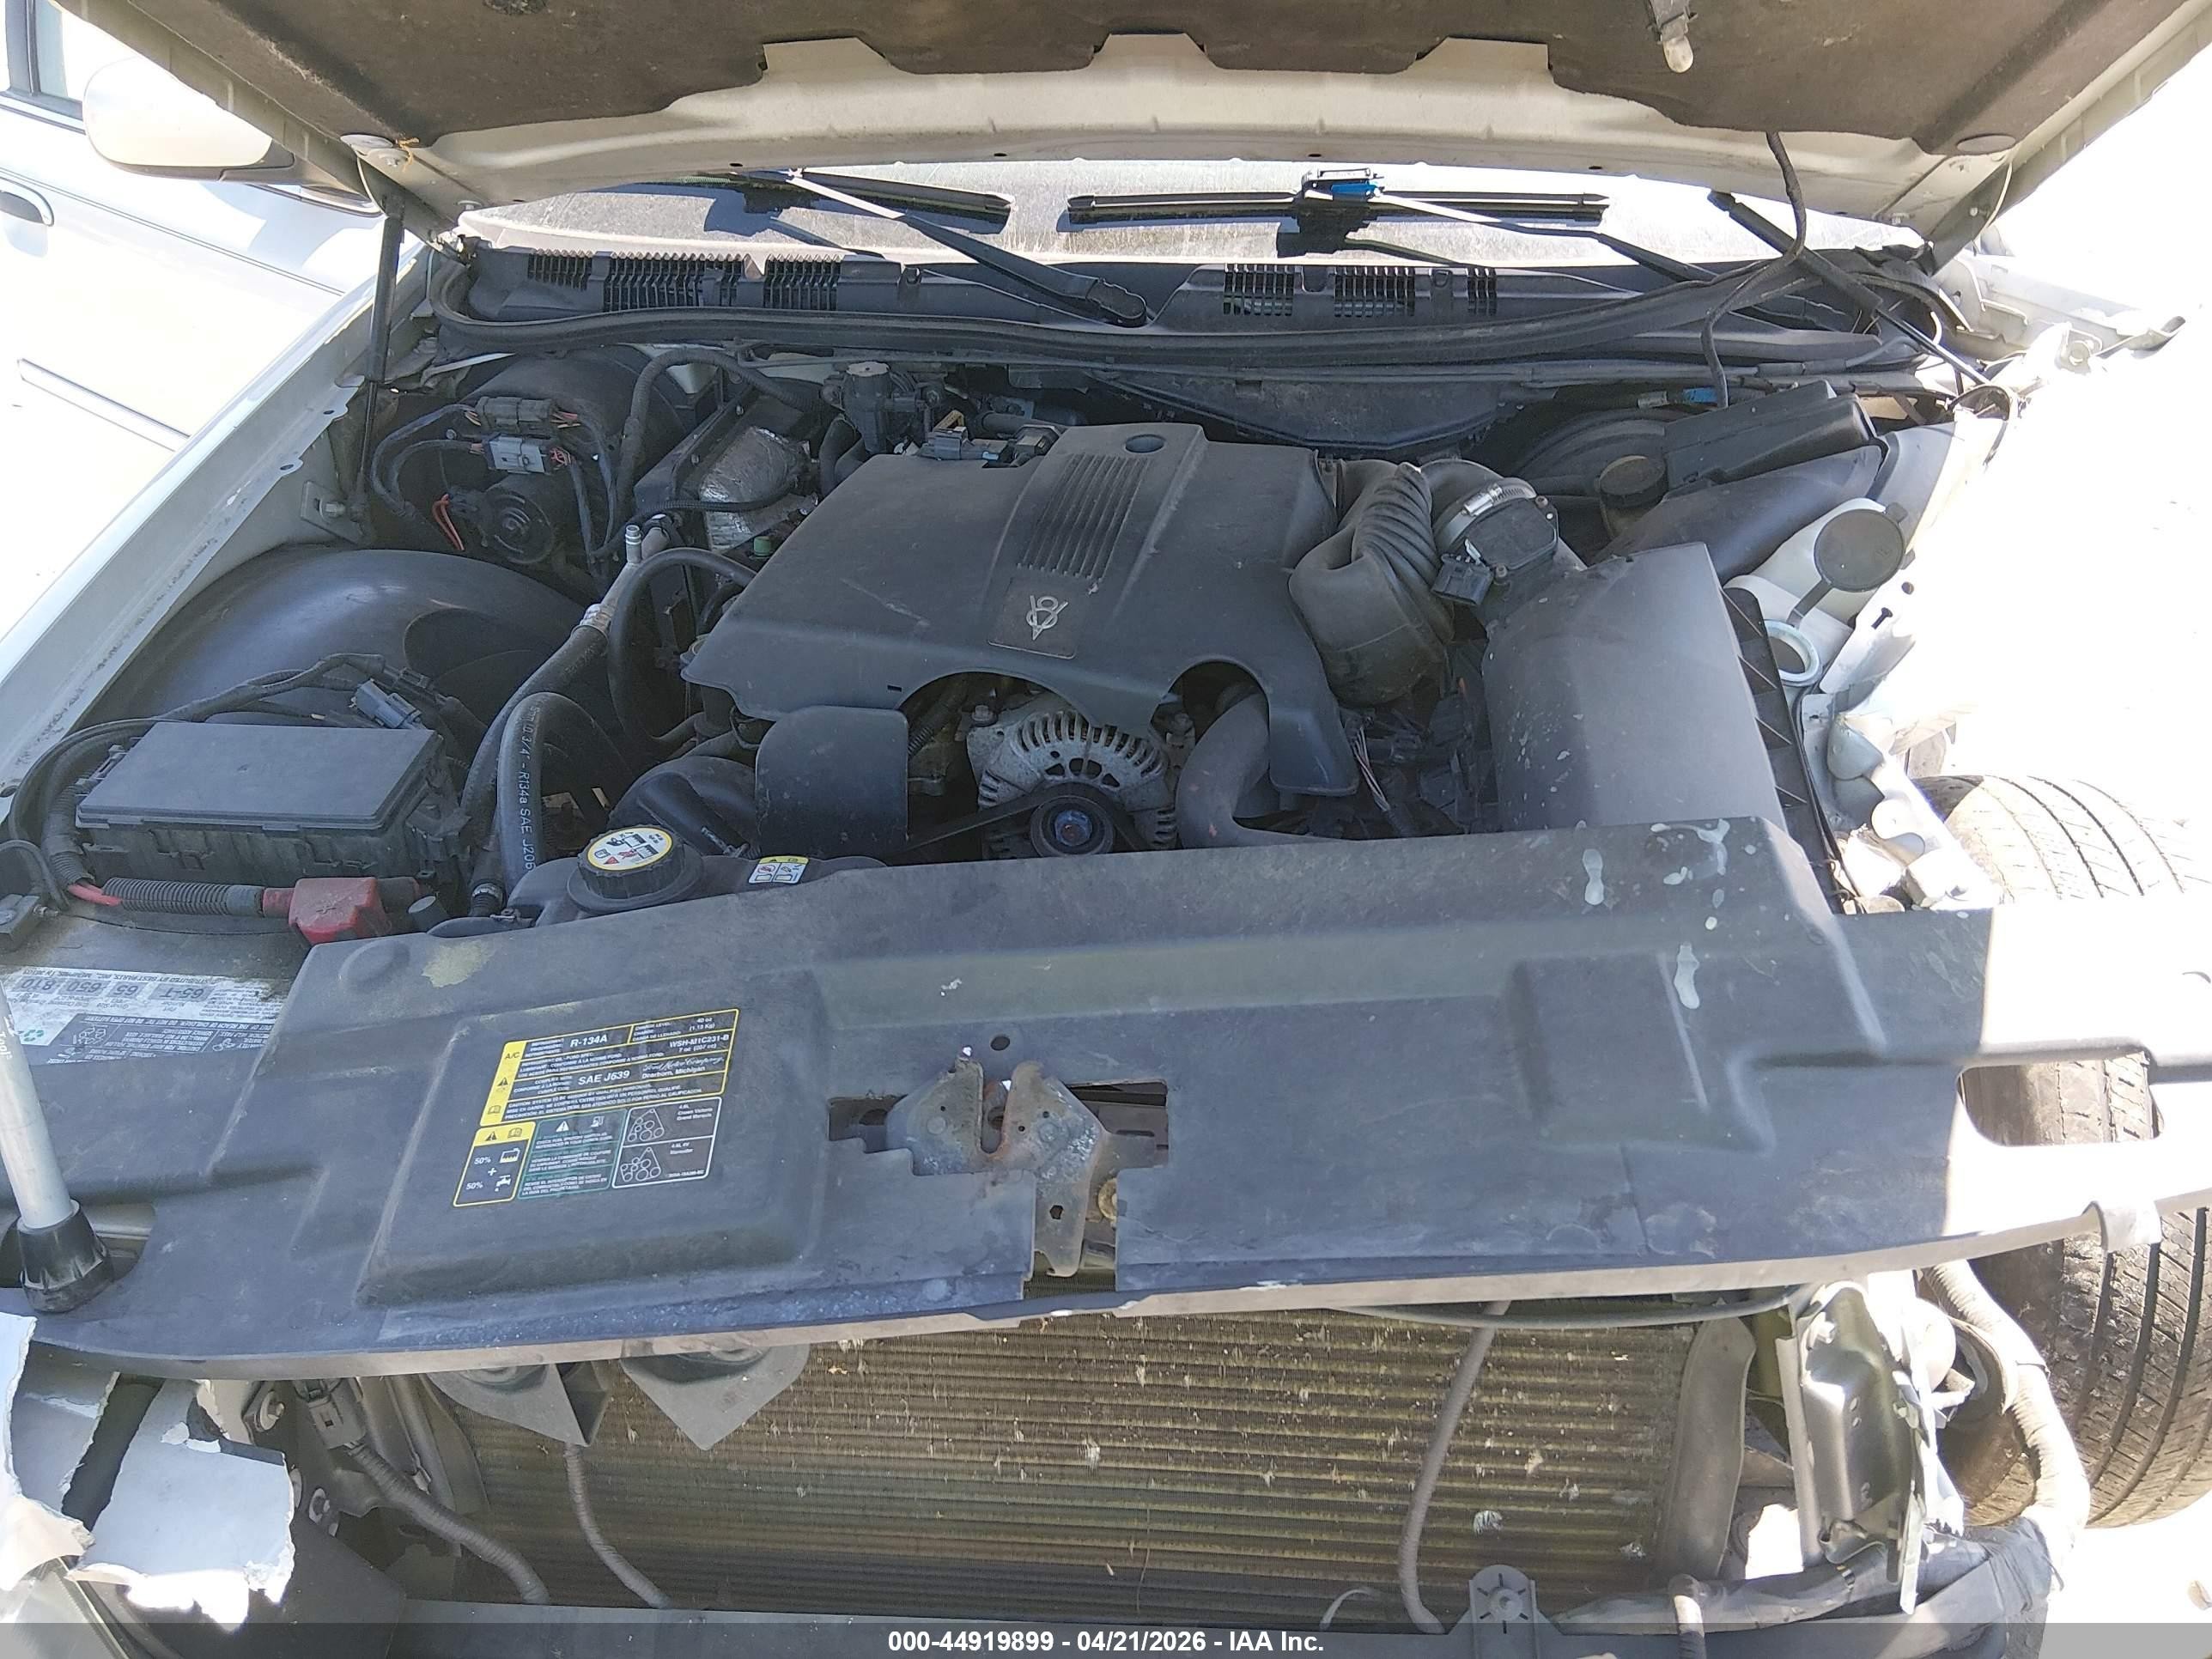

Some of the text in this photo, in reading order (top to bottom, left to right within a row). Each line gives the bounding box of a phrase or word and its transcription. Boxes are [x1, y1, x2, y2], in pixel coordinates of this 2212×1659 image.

[518, 772, 530, 805] R134a
[520, 809, 532, 834] SAE
[21, 979, 56, 991] 810
[66, 981, 102, 993] 650
[112, 985, 137, 996] 65
[159, 988, 204, 1000] 65-T
[570, 1034, 608, 1048] R-134A
[578, 1070, 630, 1085] SAE J639
[466, 1182, 483, 1190] 50%
